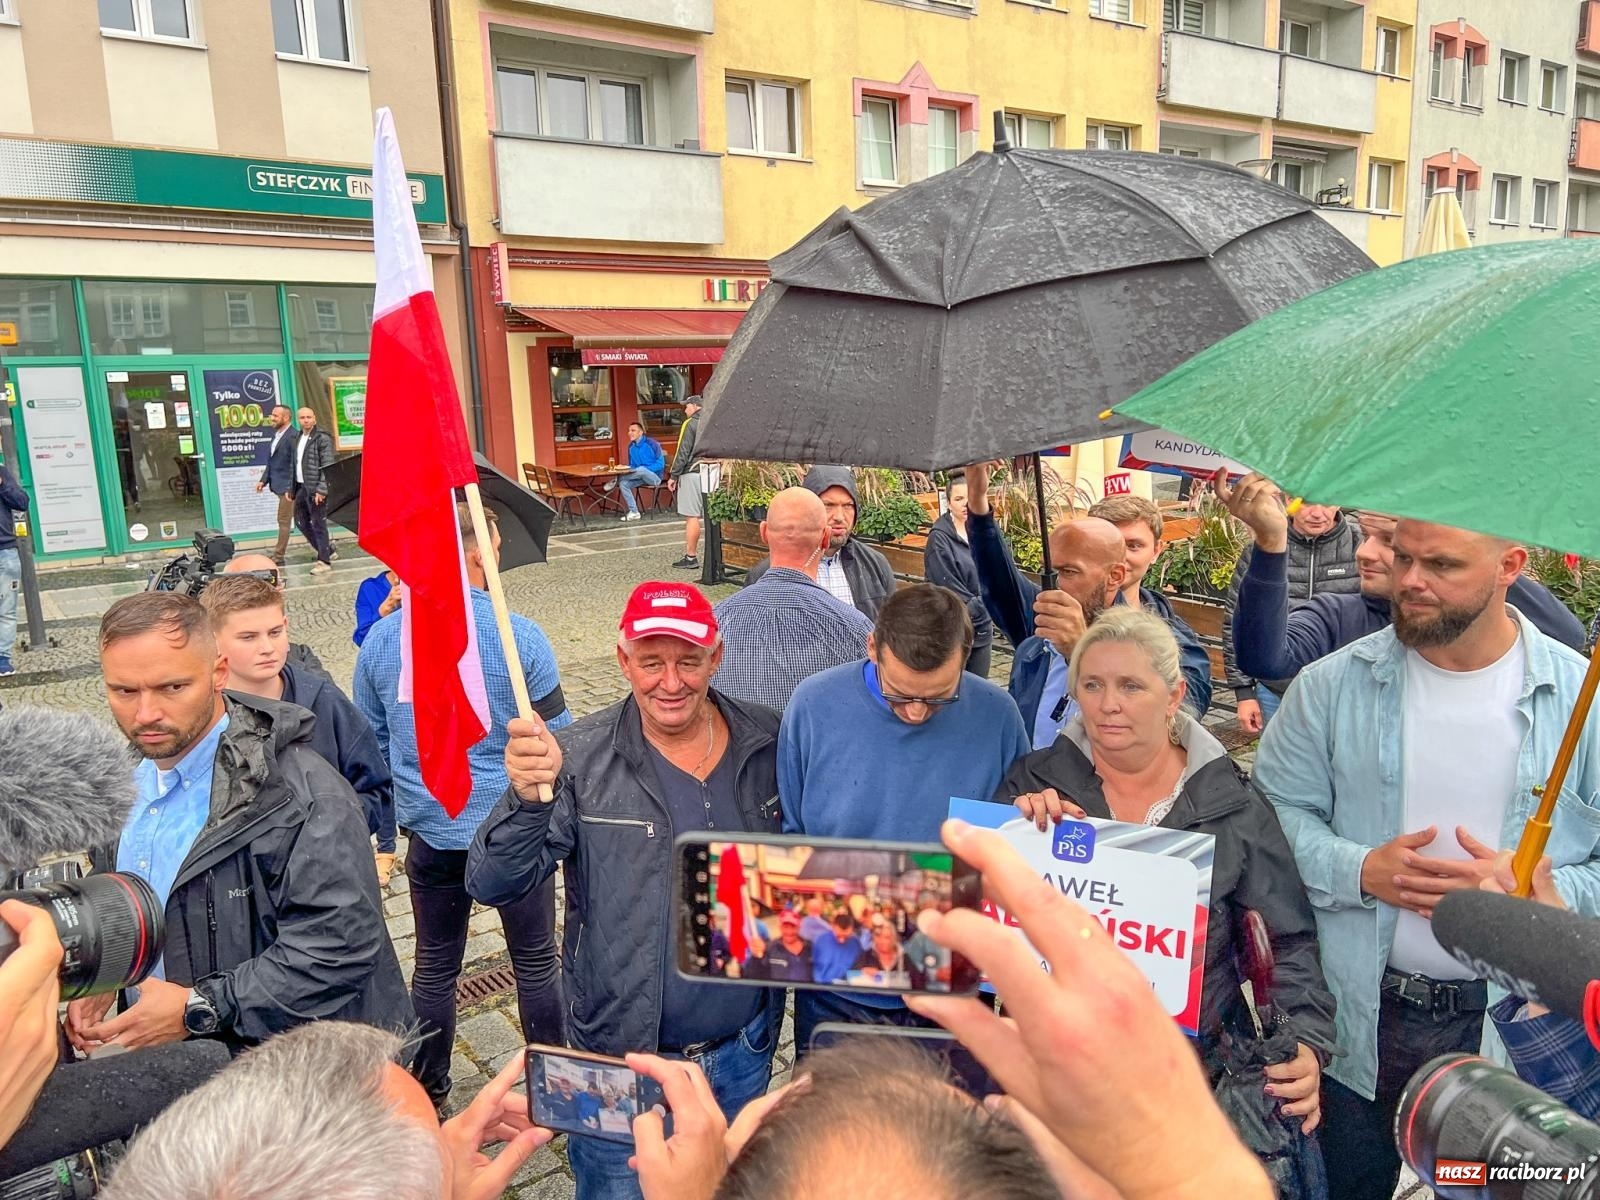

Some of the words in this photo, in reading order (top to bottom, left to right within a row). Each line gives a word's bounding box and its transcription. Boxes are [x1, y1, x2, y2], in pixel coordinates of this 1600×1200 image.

[255, 172, 342, 192] STEFCZYK
[351, 180, 418, 199] FINE
[601, 353, 622, 361] SMAKI
[624, 352, 649, 361] ŚWIATA
[213, 391, 240, 402] Tylko
[215, 403, 263, 429] 100
[1154, 439, 1227, 458] KANDYDA
[1057, 841, 1087, 858] PiS
[1043, 872, 1124, 906] AWEŁ
